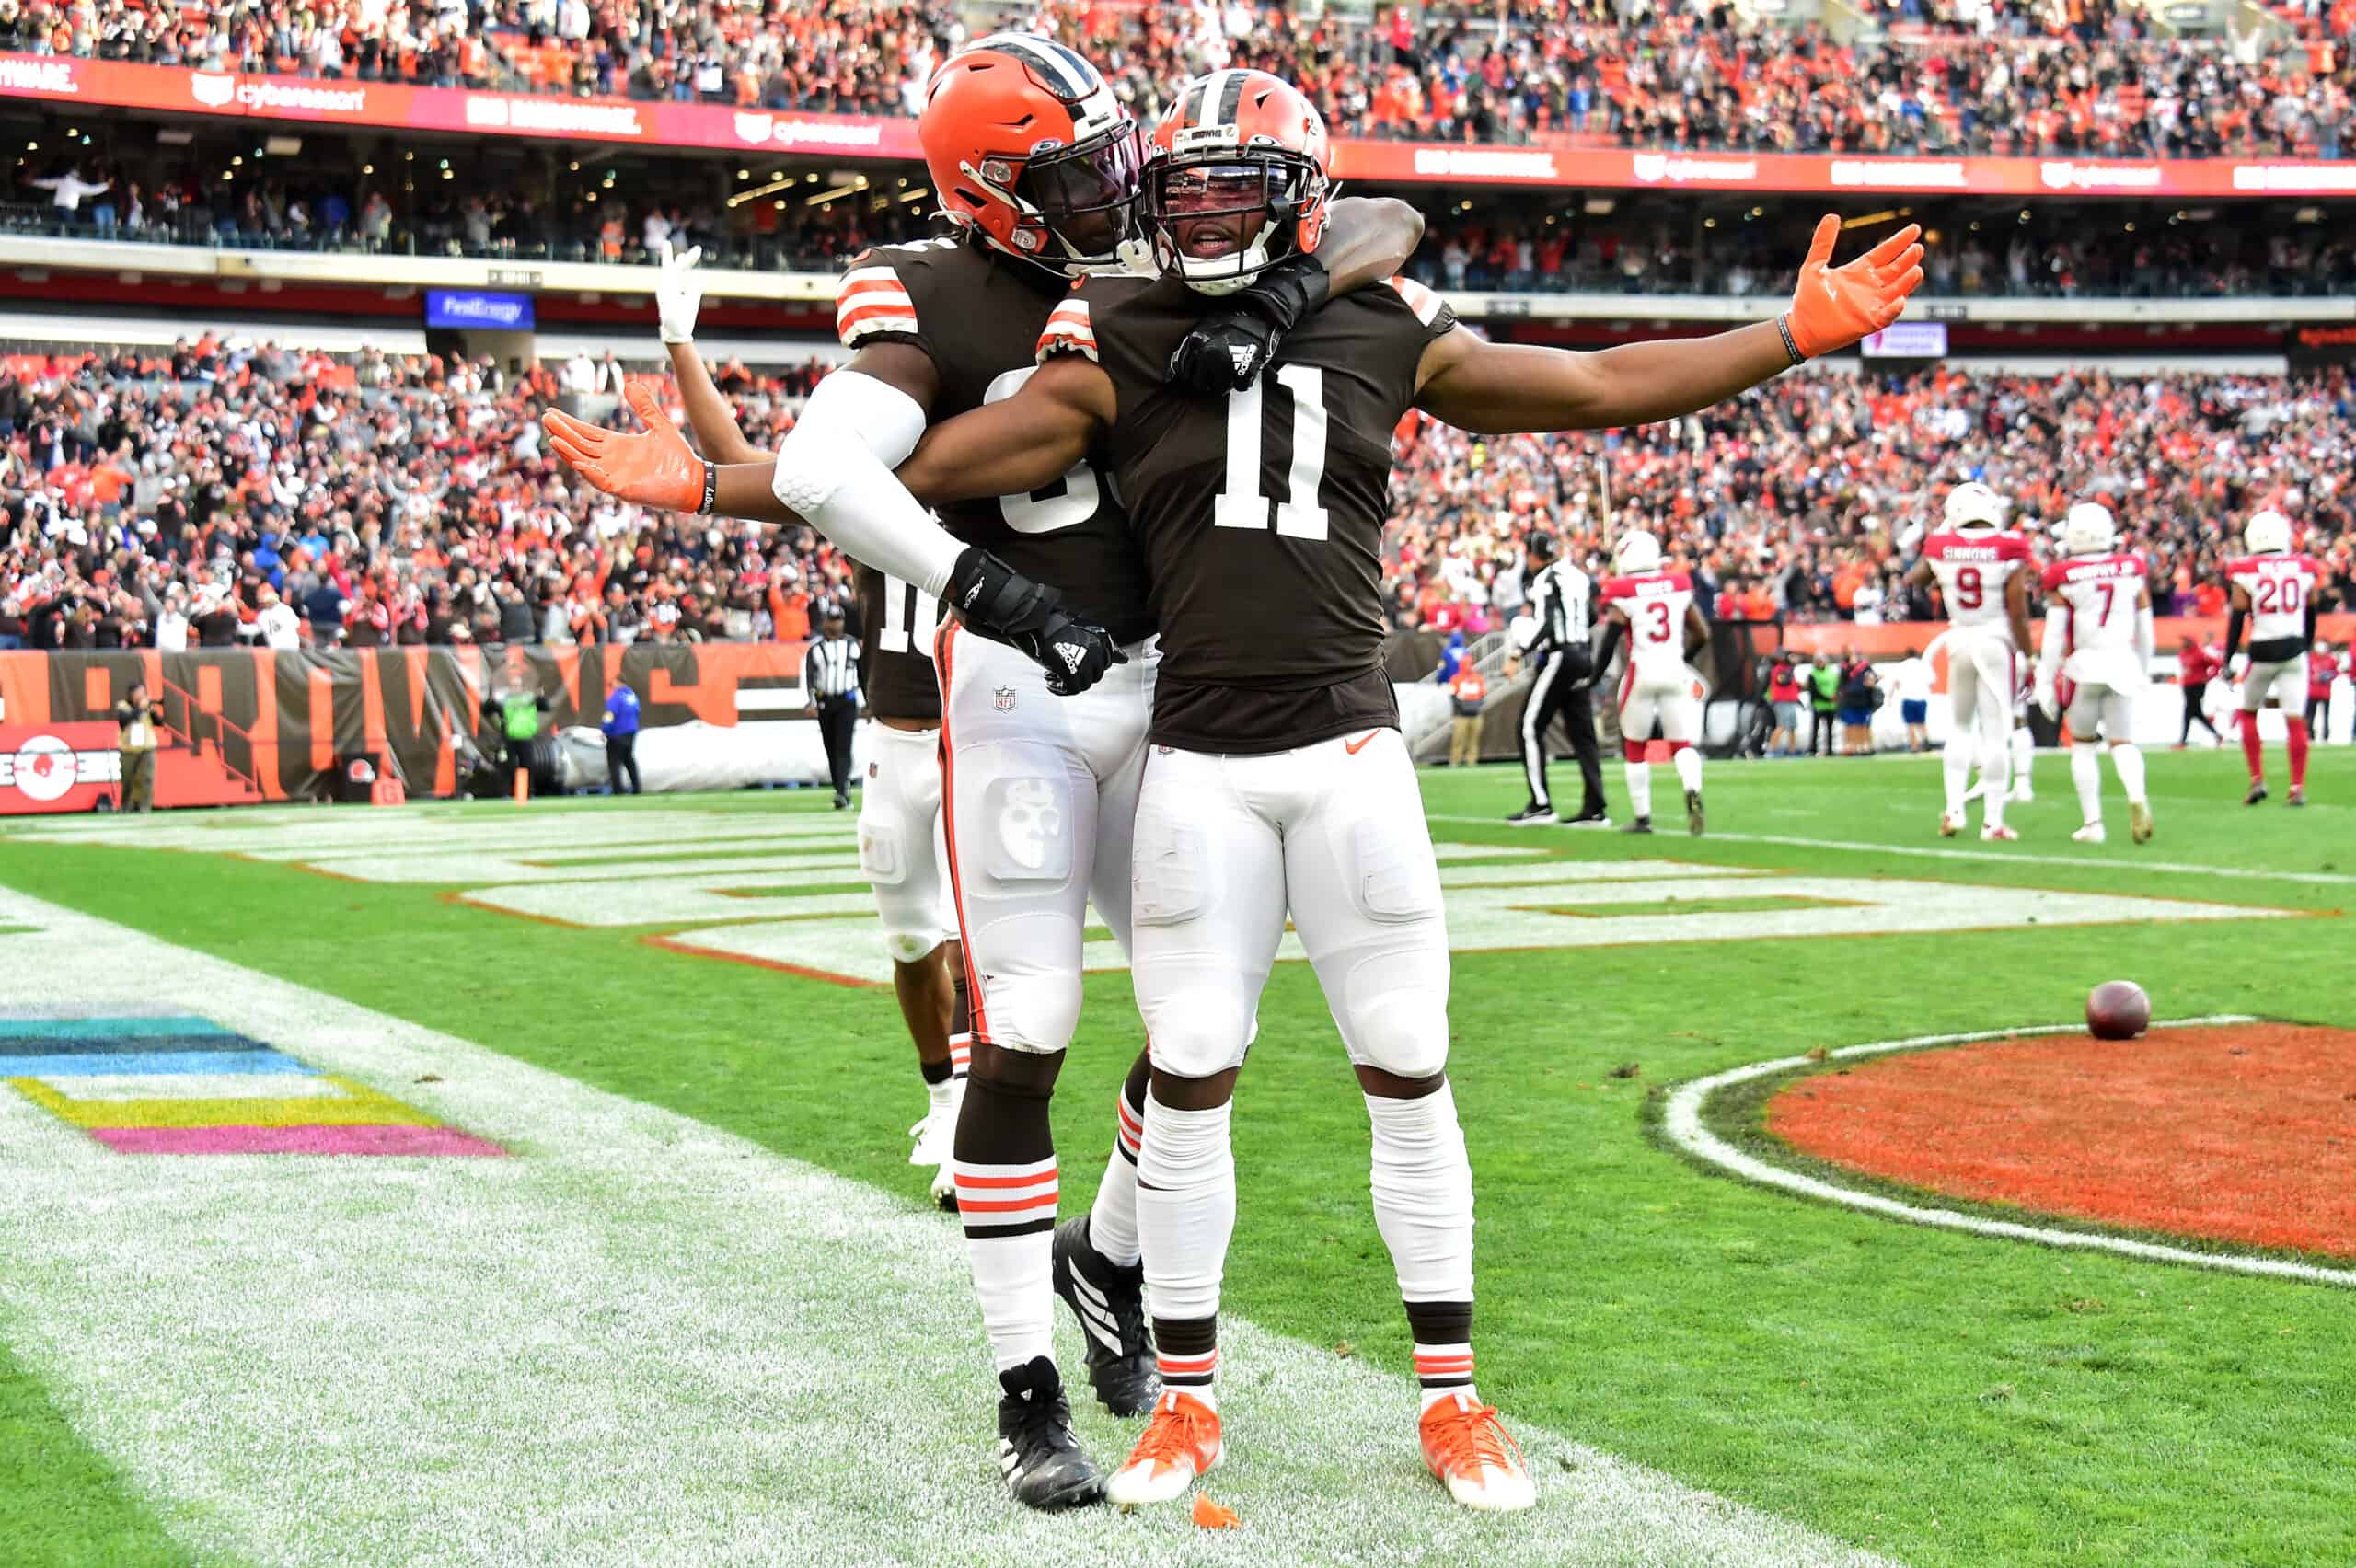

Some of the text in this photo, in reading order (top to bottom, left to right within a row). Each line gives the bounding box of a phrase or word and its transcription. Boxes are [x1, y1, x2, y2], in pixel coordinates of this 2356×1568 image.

[1191, 129, 1222, 140] BROWNS
[1214, 363, 1328, 541] 11
[1958, 568, 1982, 609] 9
[2096, 583, 2114, 627] 7
[2258, 578, 2300, 614] 20
[1646, 602, 1670, 642] 3
[1053, 641, 1079, 674] adidas
[996, 696, 1016, 709] NFL
